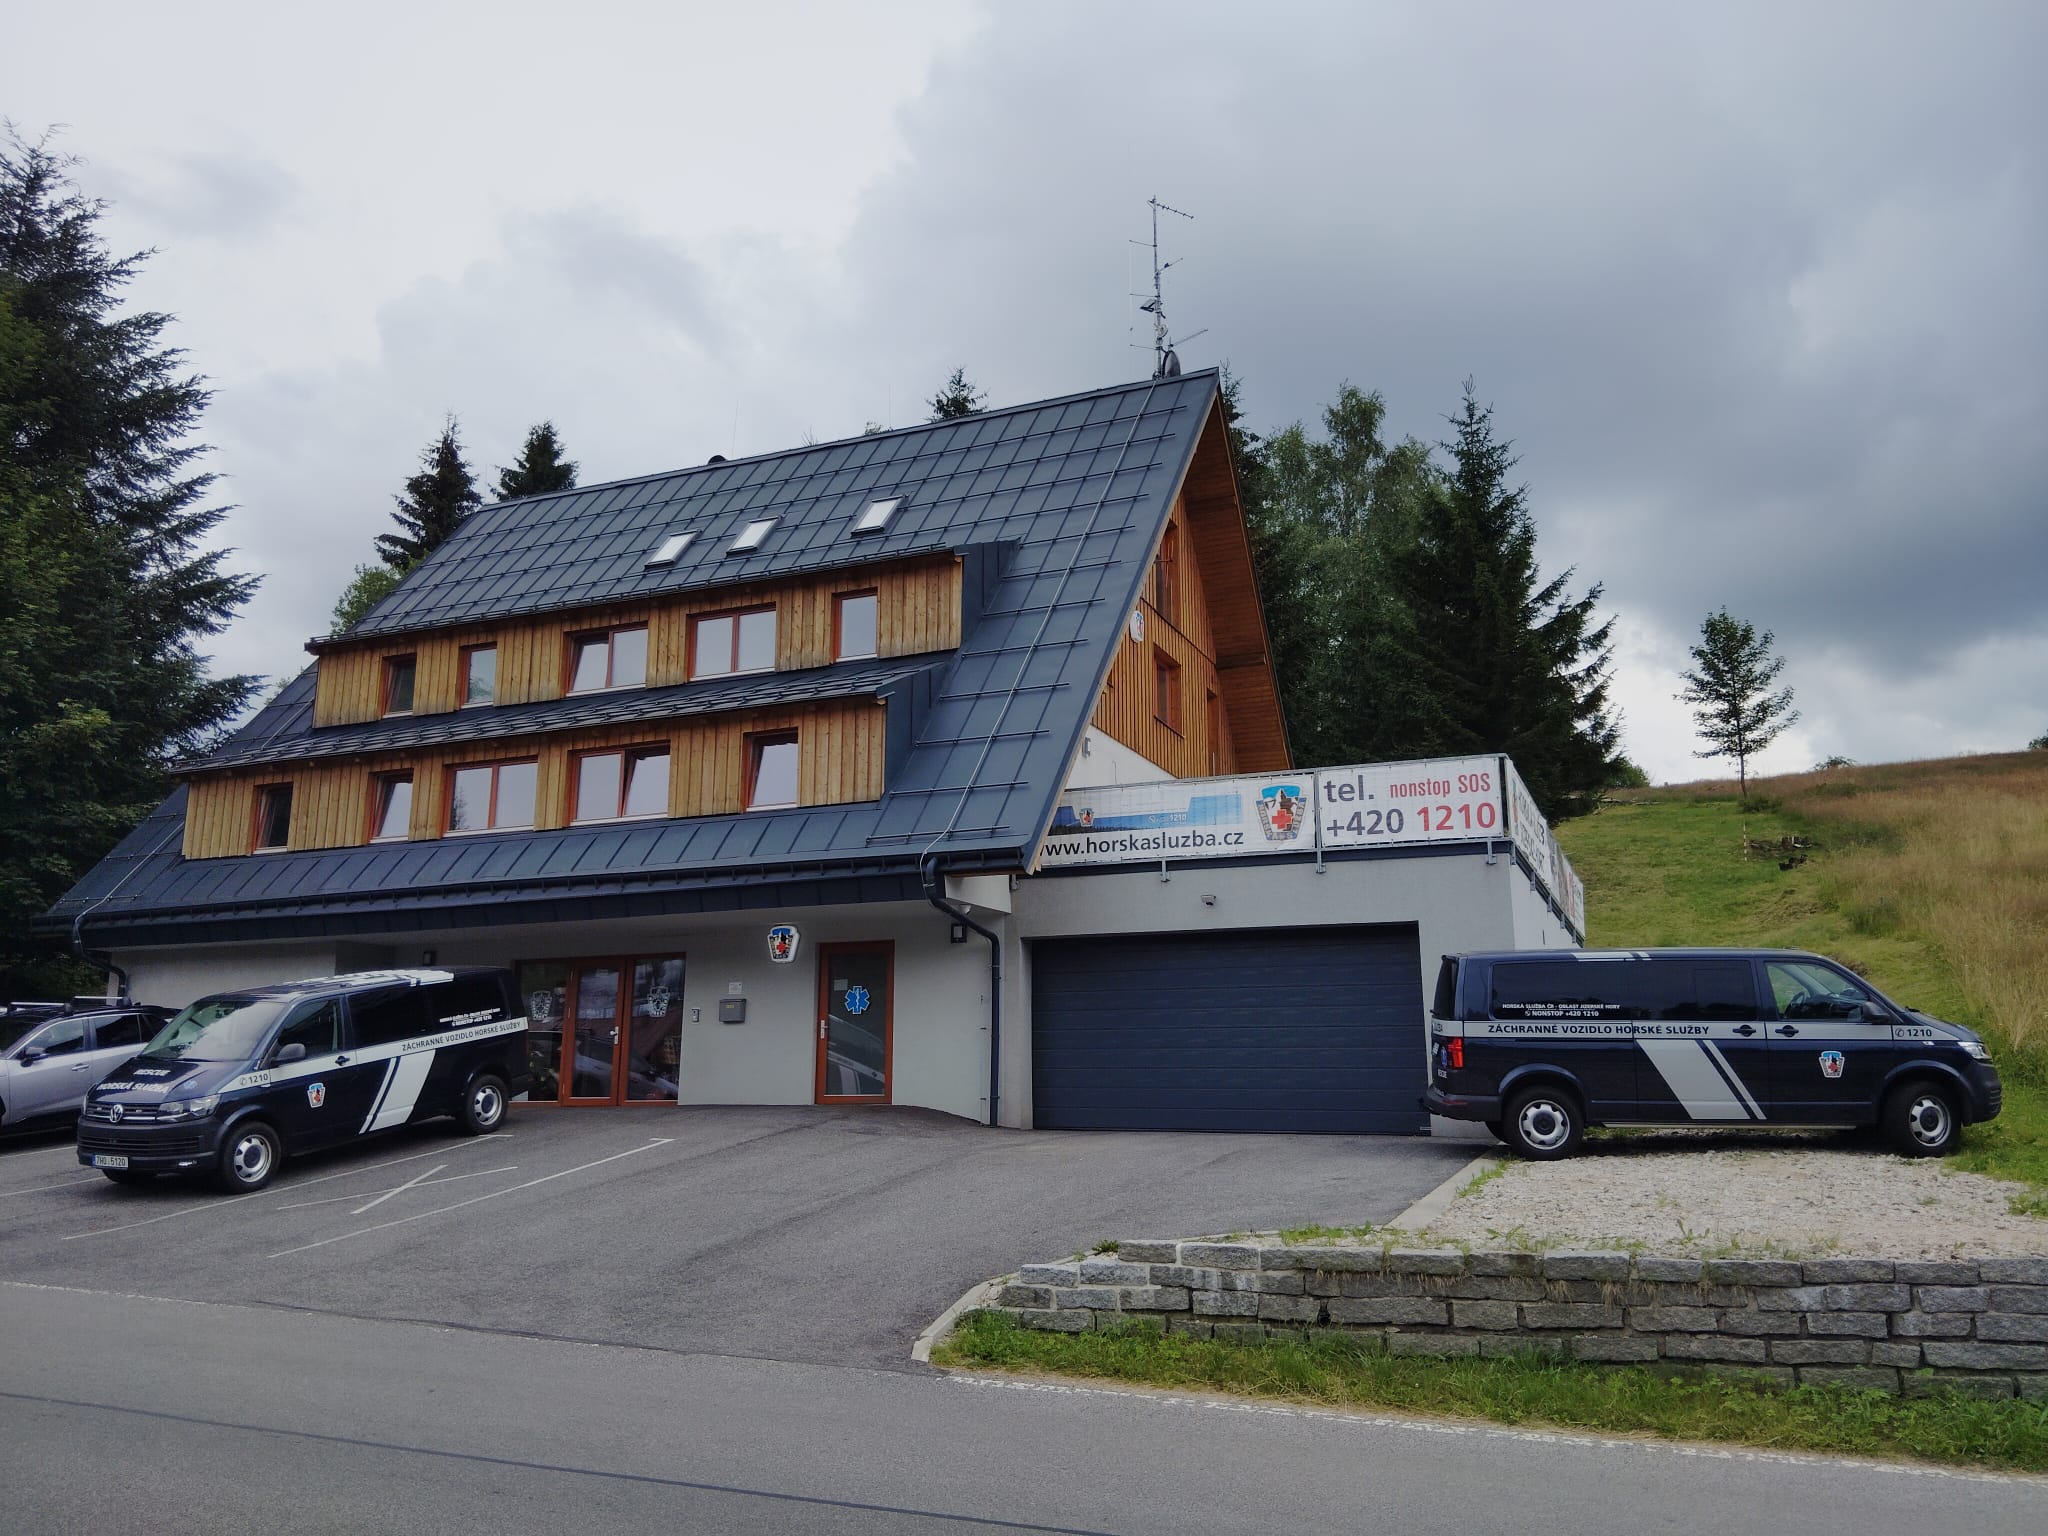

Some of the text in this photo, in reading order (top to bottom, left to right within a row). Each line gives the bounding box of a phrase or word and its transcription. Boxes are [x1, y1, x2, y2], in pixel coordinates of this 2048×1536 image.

[1323, 772, 1491, 802] tel. nonstop SOS
[1326, 808, 1404, 837] +420
[1416, 802, 1496, 832] 1210
[1040, 830, 1244, 857] ww.horskasluzba.cz
[401, 1035, 445, 1052] ZÁCHRANNÉ
[445, 1030, 474, 1043] VOZIDLO
[474, 1024, 499, 1037] HORSKÉ
[500, 1020, 521, 1033] SLUŽBY
[1488, 1023, 1710, 1035] ZÁCHRANNÉ VOZIDLO HORSKÉ SLUŽBY
[1907, 1028, 1933, 1037] 1210
[249, 1073, 269, 1085] 1210
